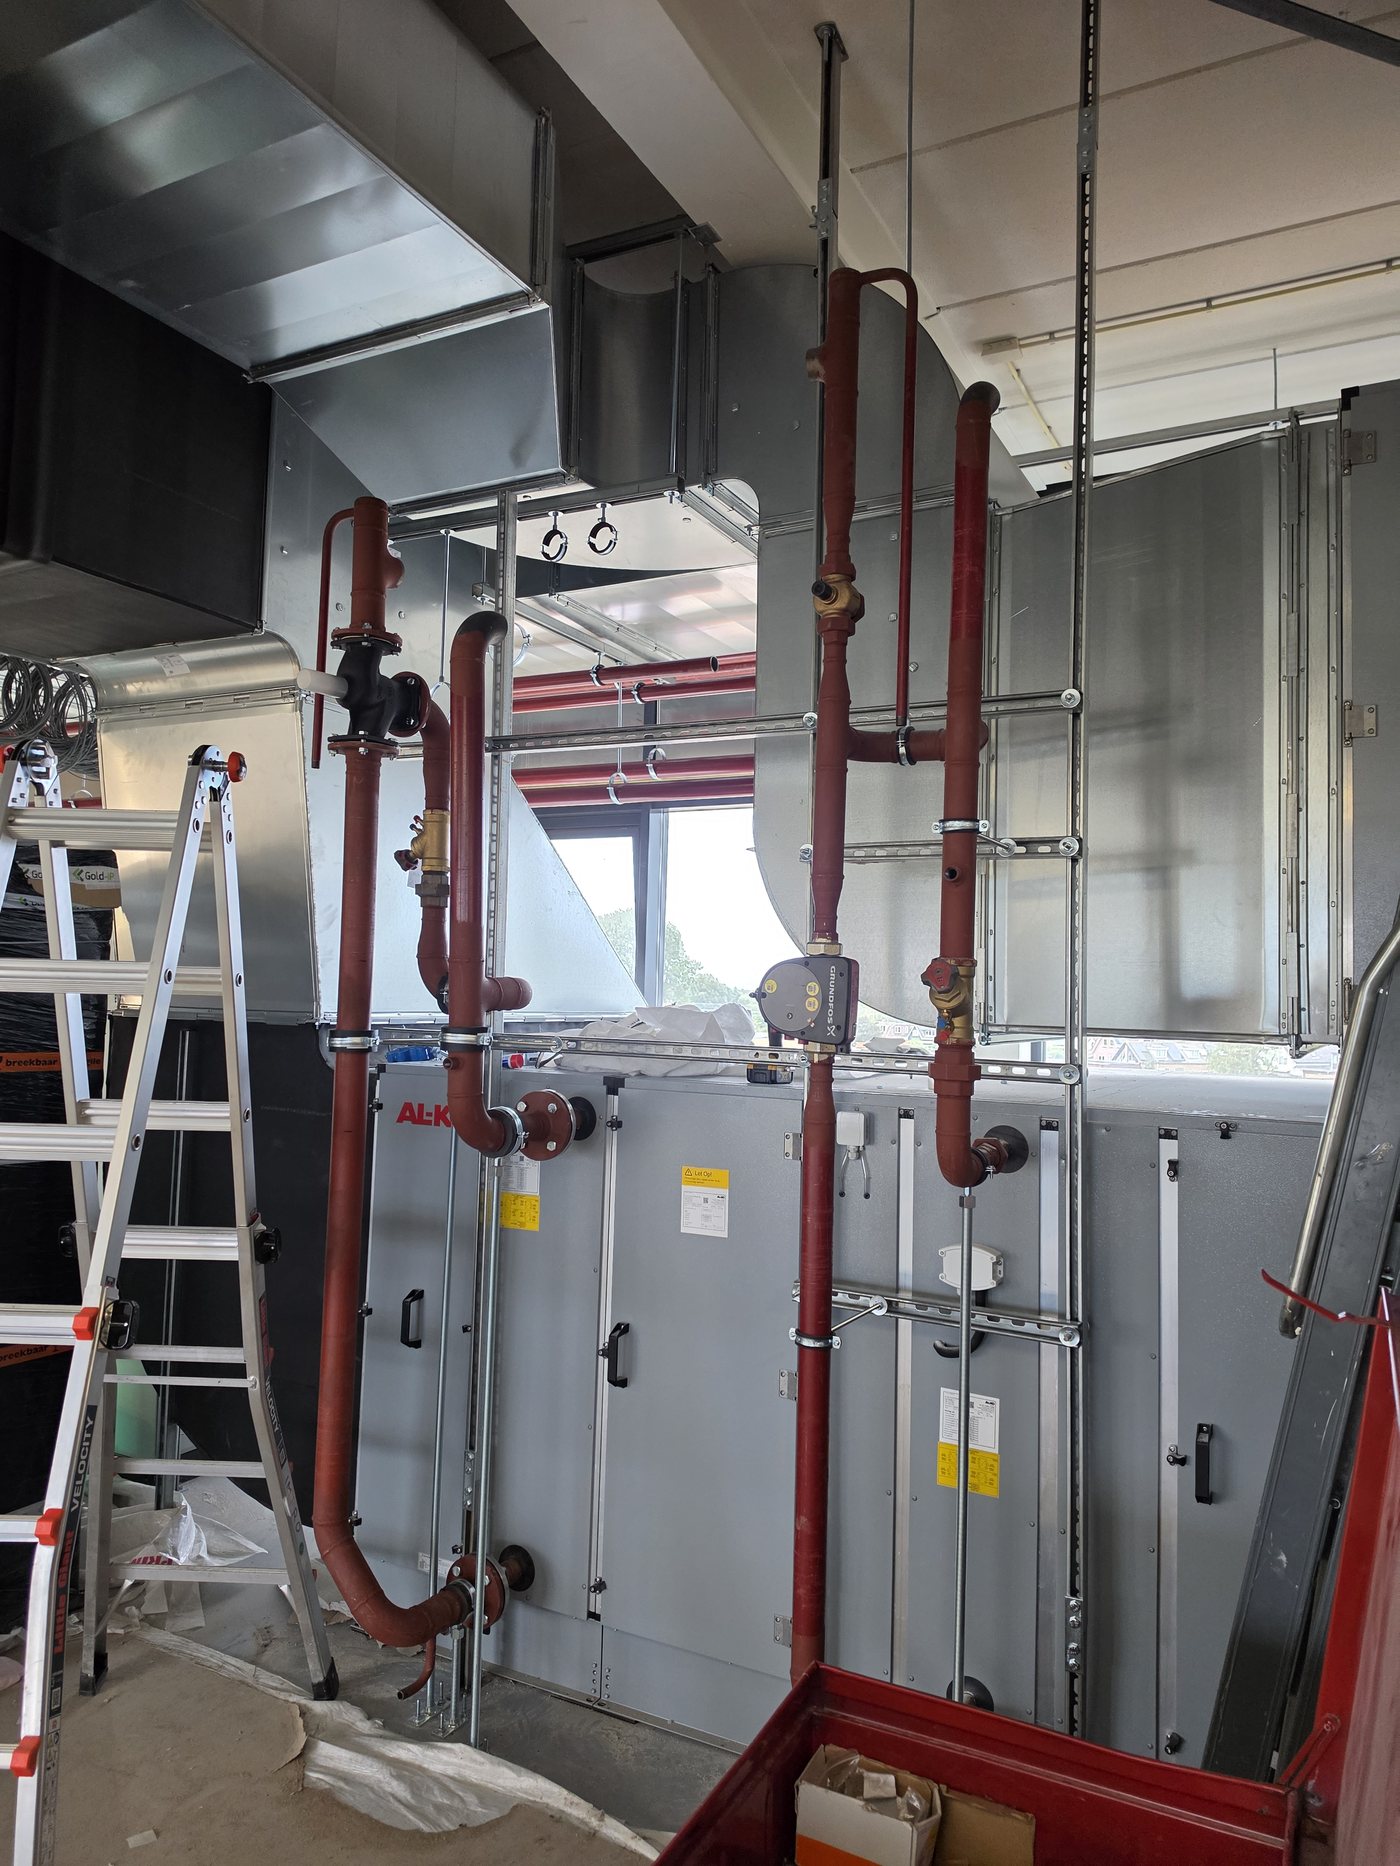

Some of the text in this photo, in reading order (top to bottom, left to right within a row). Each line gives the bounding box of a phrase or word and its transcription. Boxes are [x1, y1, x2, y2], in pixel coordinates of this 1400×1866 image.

[827, 965, 836, 1025] GRUNDFOS
[5, 1058, 58, 1067] breekbaar
[396, 1102, 454, 1128] AL-K
[264, 1375, 280, 1433] VELOCITY
[70, 1415, 94, 1513] VELOCITY
